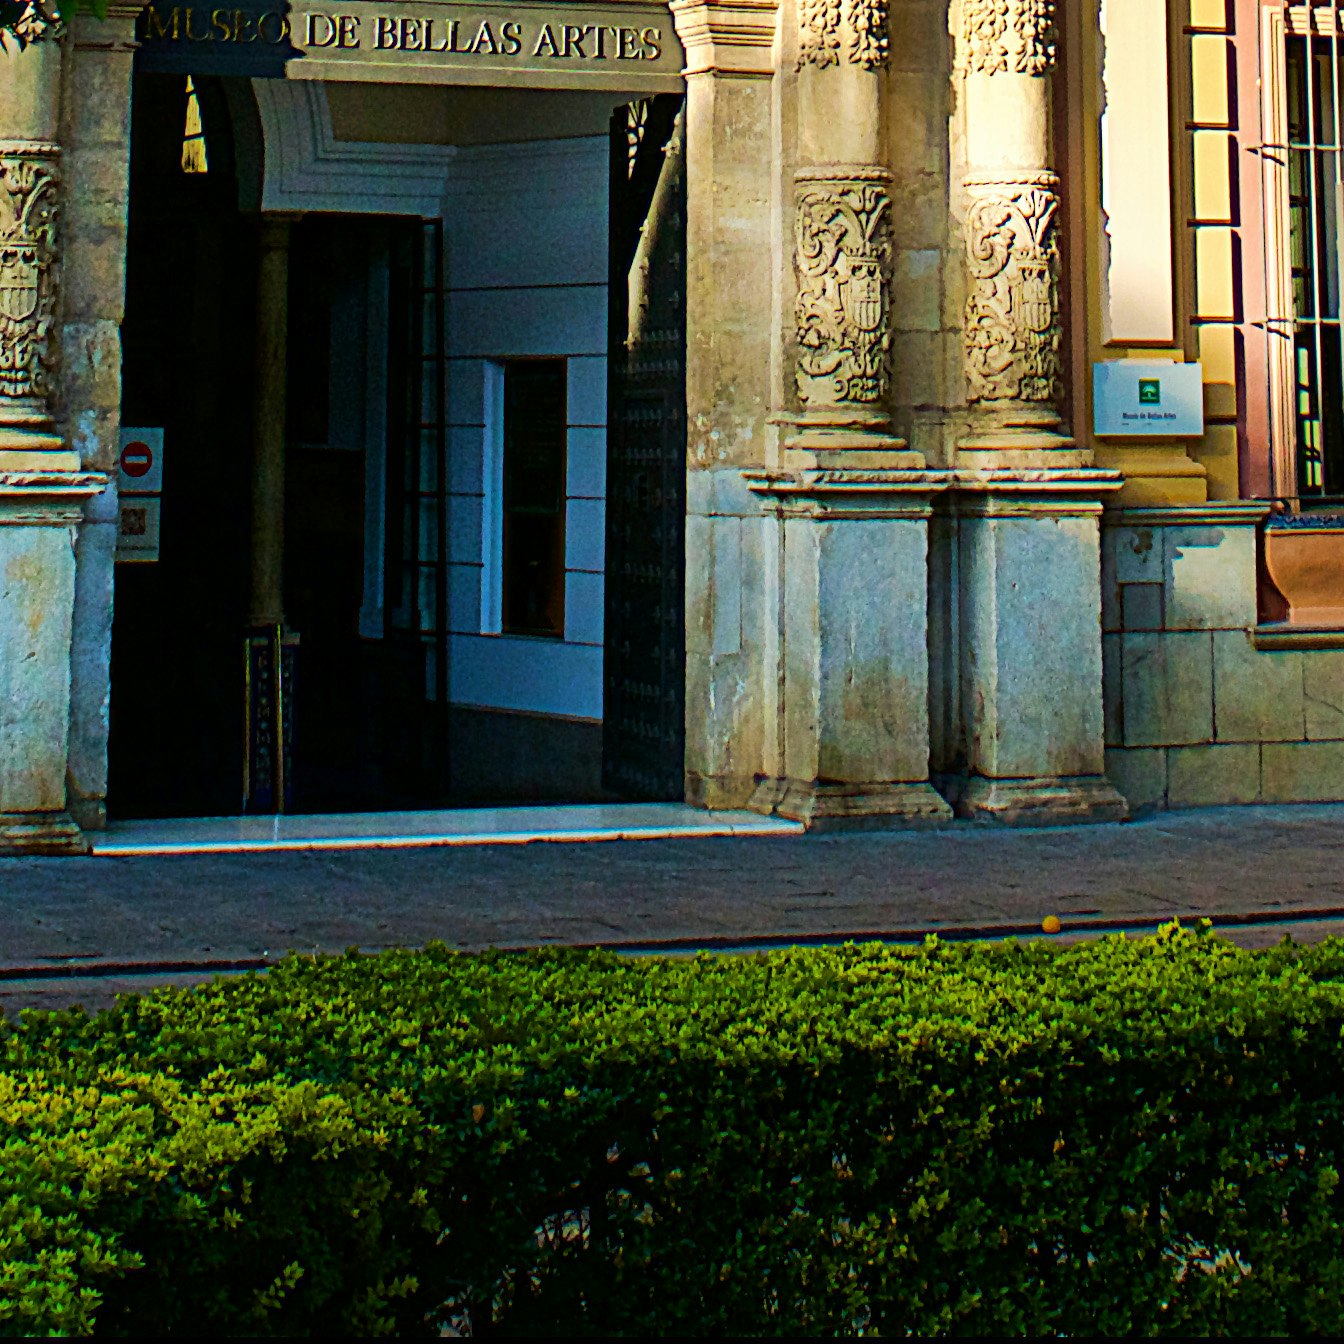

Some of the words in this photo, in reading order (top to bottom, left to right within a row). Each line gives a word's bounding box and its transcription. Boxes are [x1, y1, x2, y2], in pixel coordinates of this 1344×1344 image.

[144, 6, 291, 44] MUSEO
[304, 13, 361, 49] DE
[373, 15, 522, 55] BELLAS
[532, 23, 663, 61] ARTES
